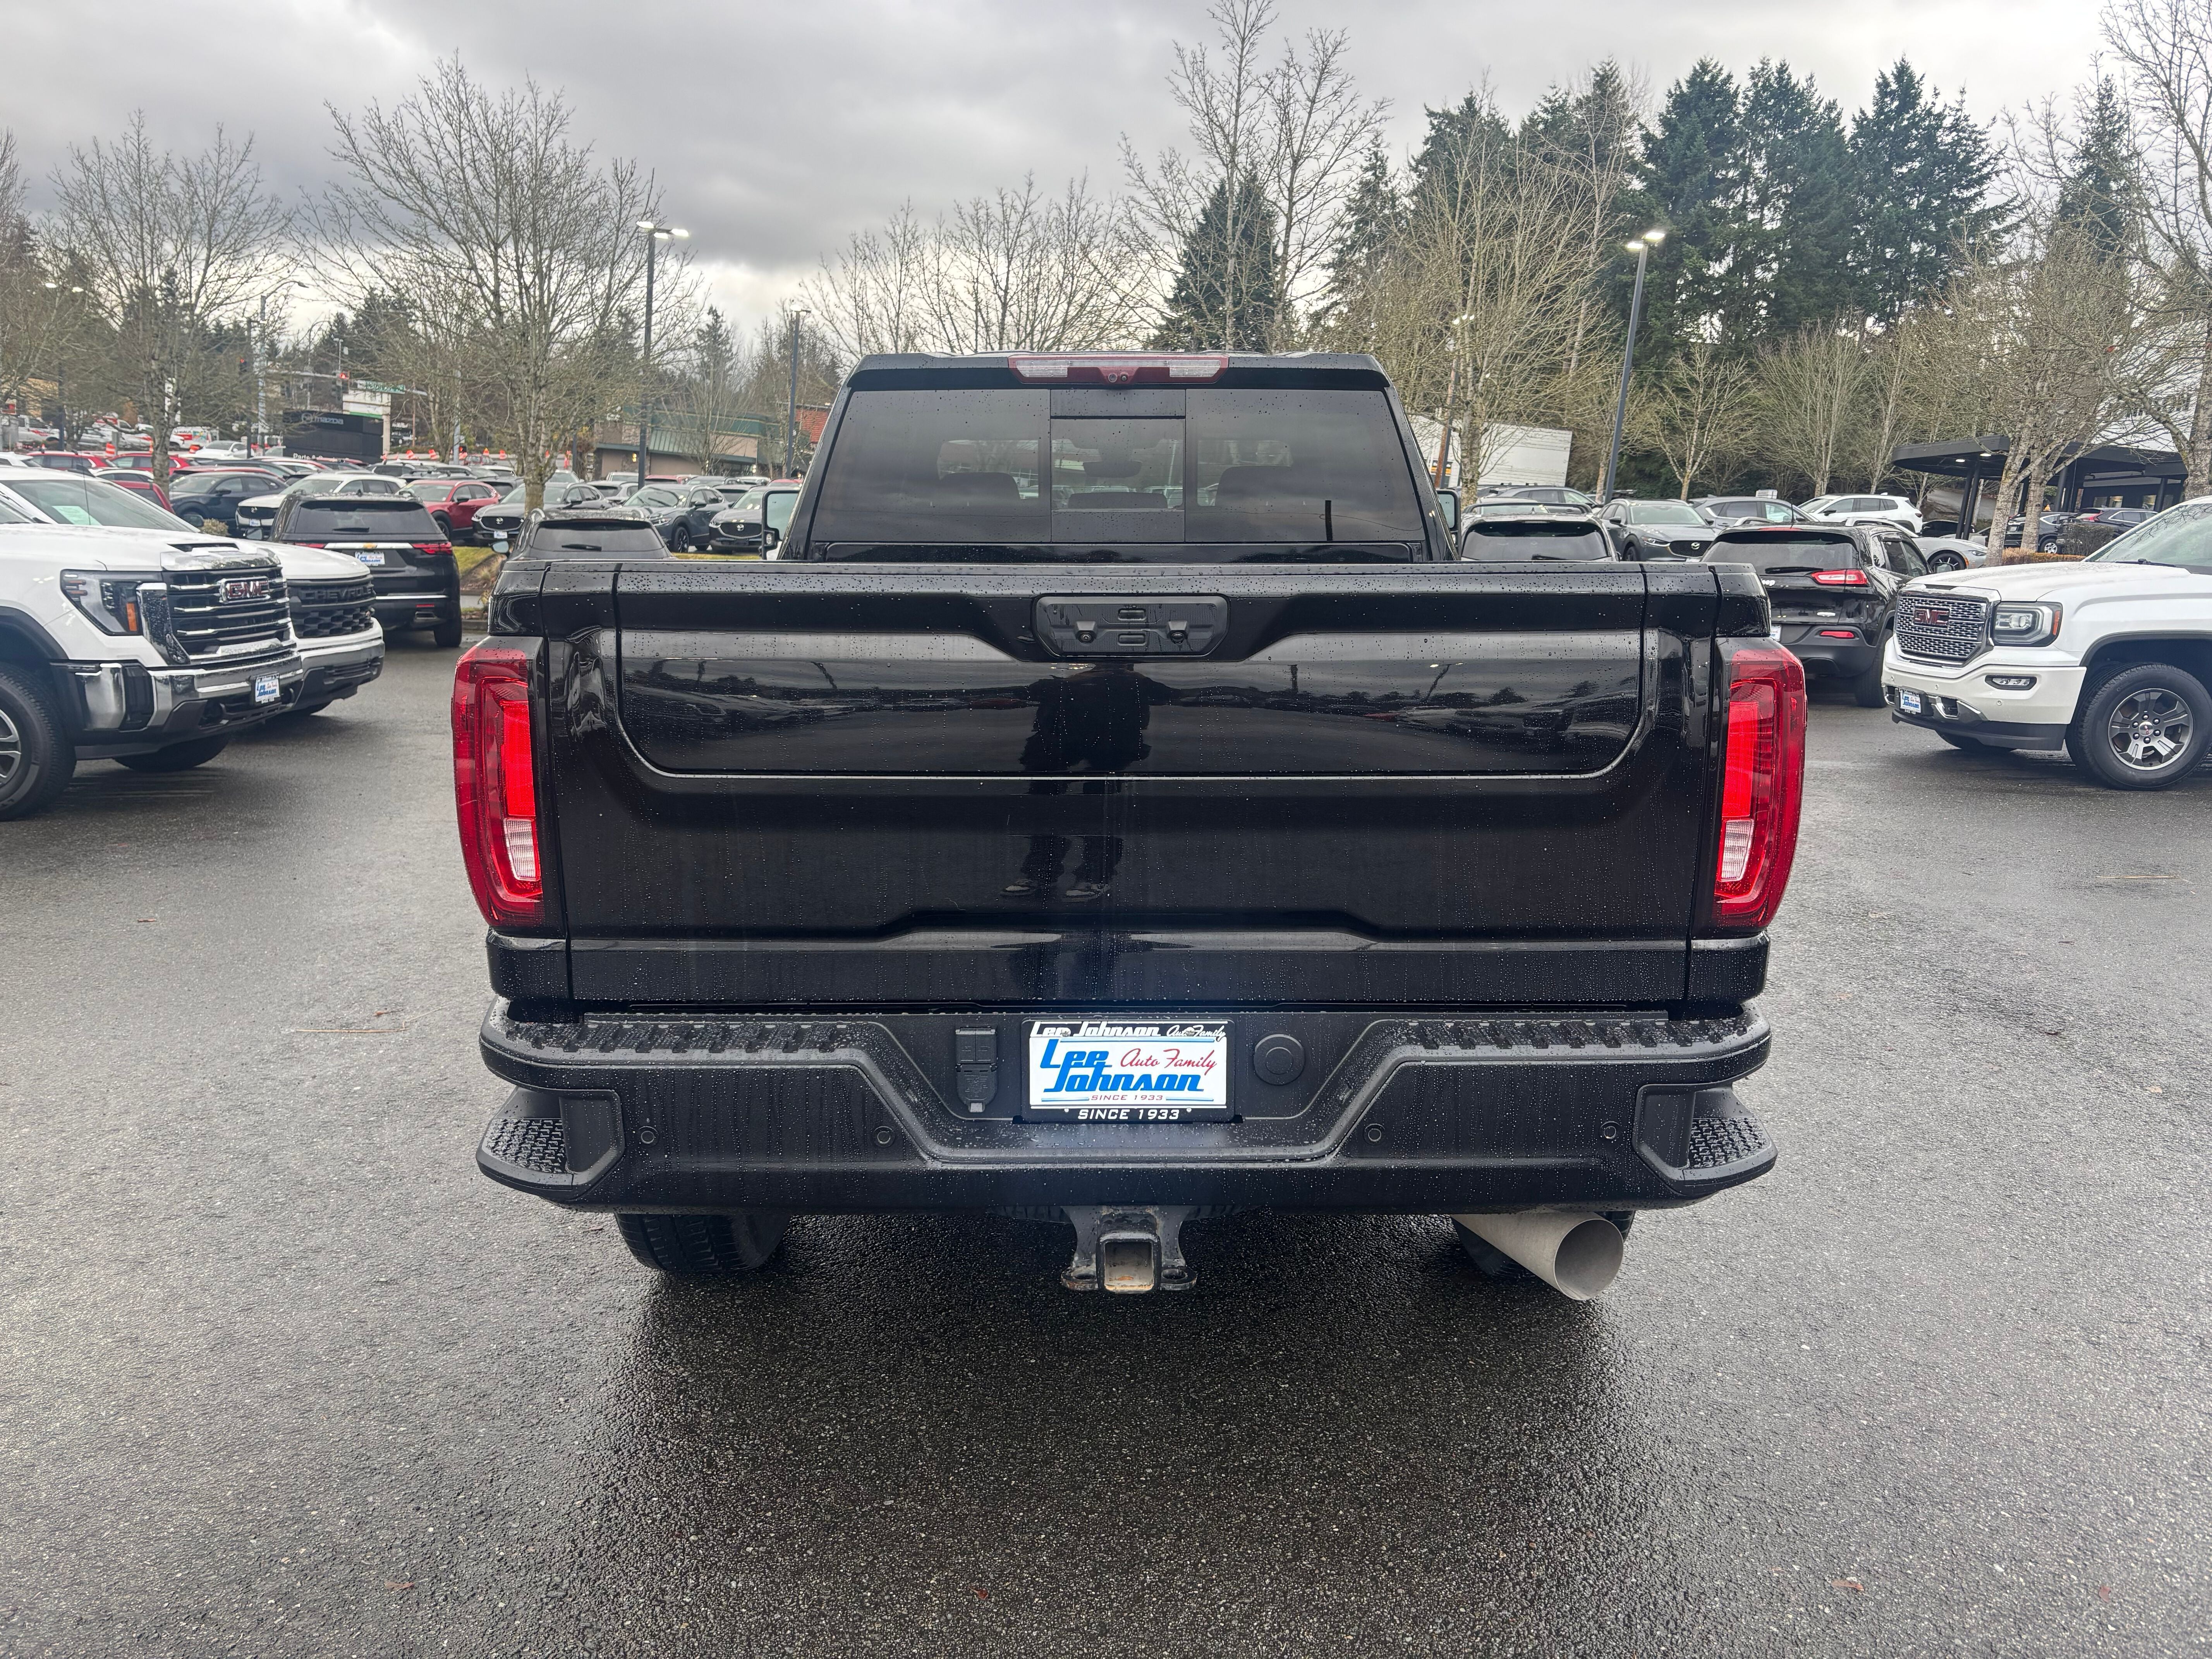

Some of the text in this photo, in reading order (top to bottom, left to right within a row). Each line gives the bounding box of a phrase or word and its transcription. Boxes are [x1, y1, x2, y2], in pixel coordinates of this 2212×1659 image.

[226, 581, 269, 599] GMC
[302, 585, 373, 600] CHEVROLE
[1914, 608, 1949, 625] GMC
[1073, 1021, 1161, 1037] Johnson
[1166, 1025, 1191, 1037] Aut
[1193, 1025, 1226, 1042] Family
[1040, 1039, 1217, 1076] Lee Auto Family
[1043, 1066, 1204, 1093] Johnson
[1078, 1109, 1180, 1120] SINCE 1933
